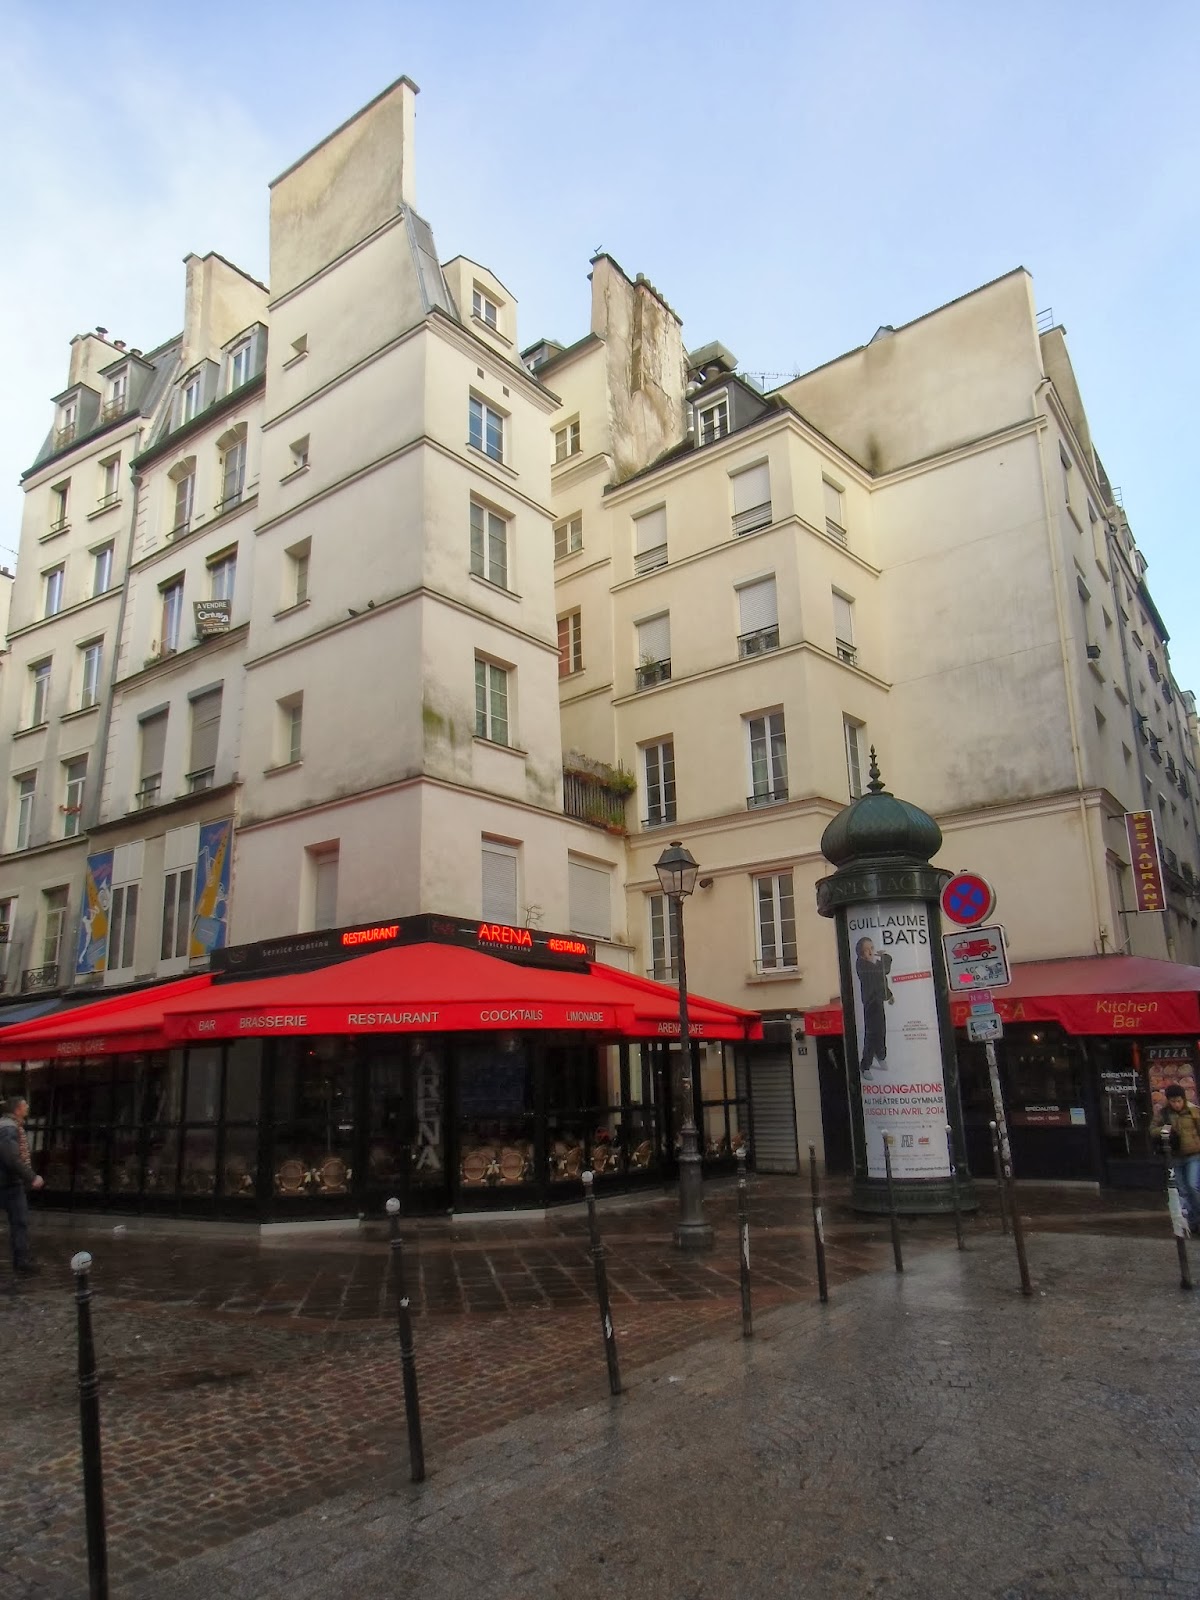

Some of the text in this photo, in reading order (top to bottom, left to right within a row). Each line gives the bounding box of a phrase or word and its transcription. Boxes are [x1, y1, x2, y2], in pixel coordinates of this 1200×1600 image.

[1132, 812, 1158, 910] RESTAURANT
[848, 915, 926, 931] GUILLAUME
[342, 925, 399, 945] RESTAURANT
[478, 923, 532, 946] ARENA
[881, 929, 928, 946] BATS
[477, 939, 503, 949] Service
[1096, 1000, 1158, 1014] Kitchen
[348, 1012, 439, 1025] RESTAURANT
[480, 1010, 543, 1022] COCKTAILS
[565, 1011, 604, 1022] LIMONADE
[955, 1003, 1026, 1025] PZA
[198, 1019, 216, 1031] BAR
[239, 1015, 307, 1029] BRASSERIE
[813, 1020, 832, 1030] Bar
[1112, 1014, 1142, 1028] Bar
[657, 1022, 681, 1034] ARENA
[1149, 1048, 1188, 1058] PIZZA
[862, 1083, 943, 1095] PROLONGATIONS
[911, 1096, 944, 1104] GYMNASE
[416, 1052, 441, 1170] ARENA
[900, 1107, 924, 1115] AVRIL
[926, 1106, 945, 1114] 2014
